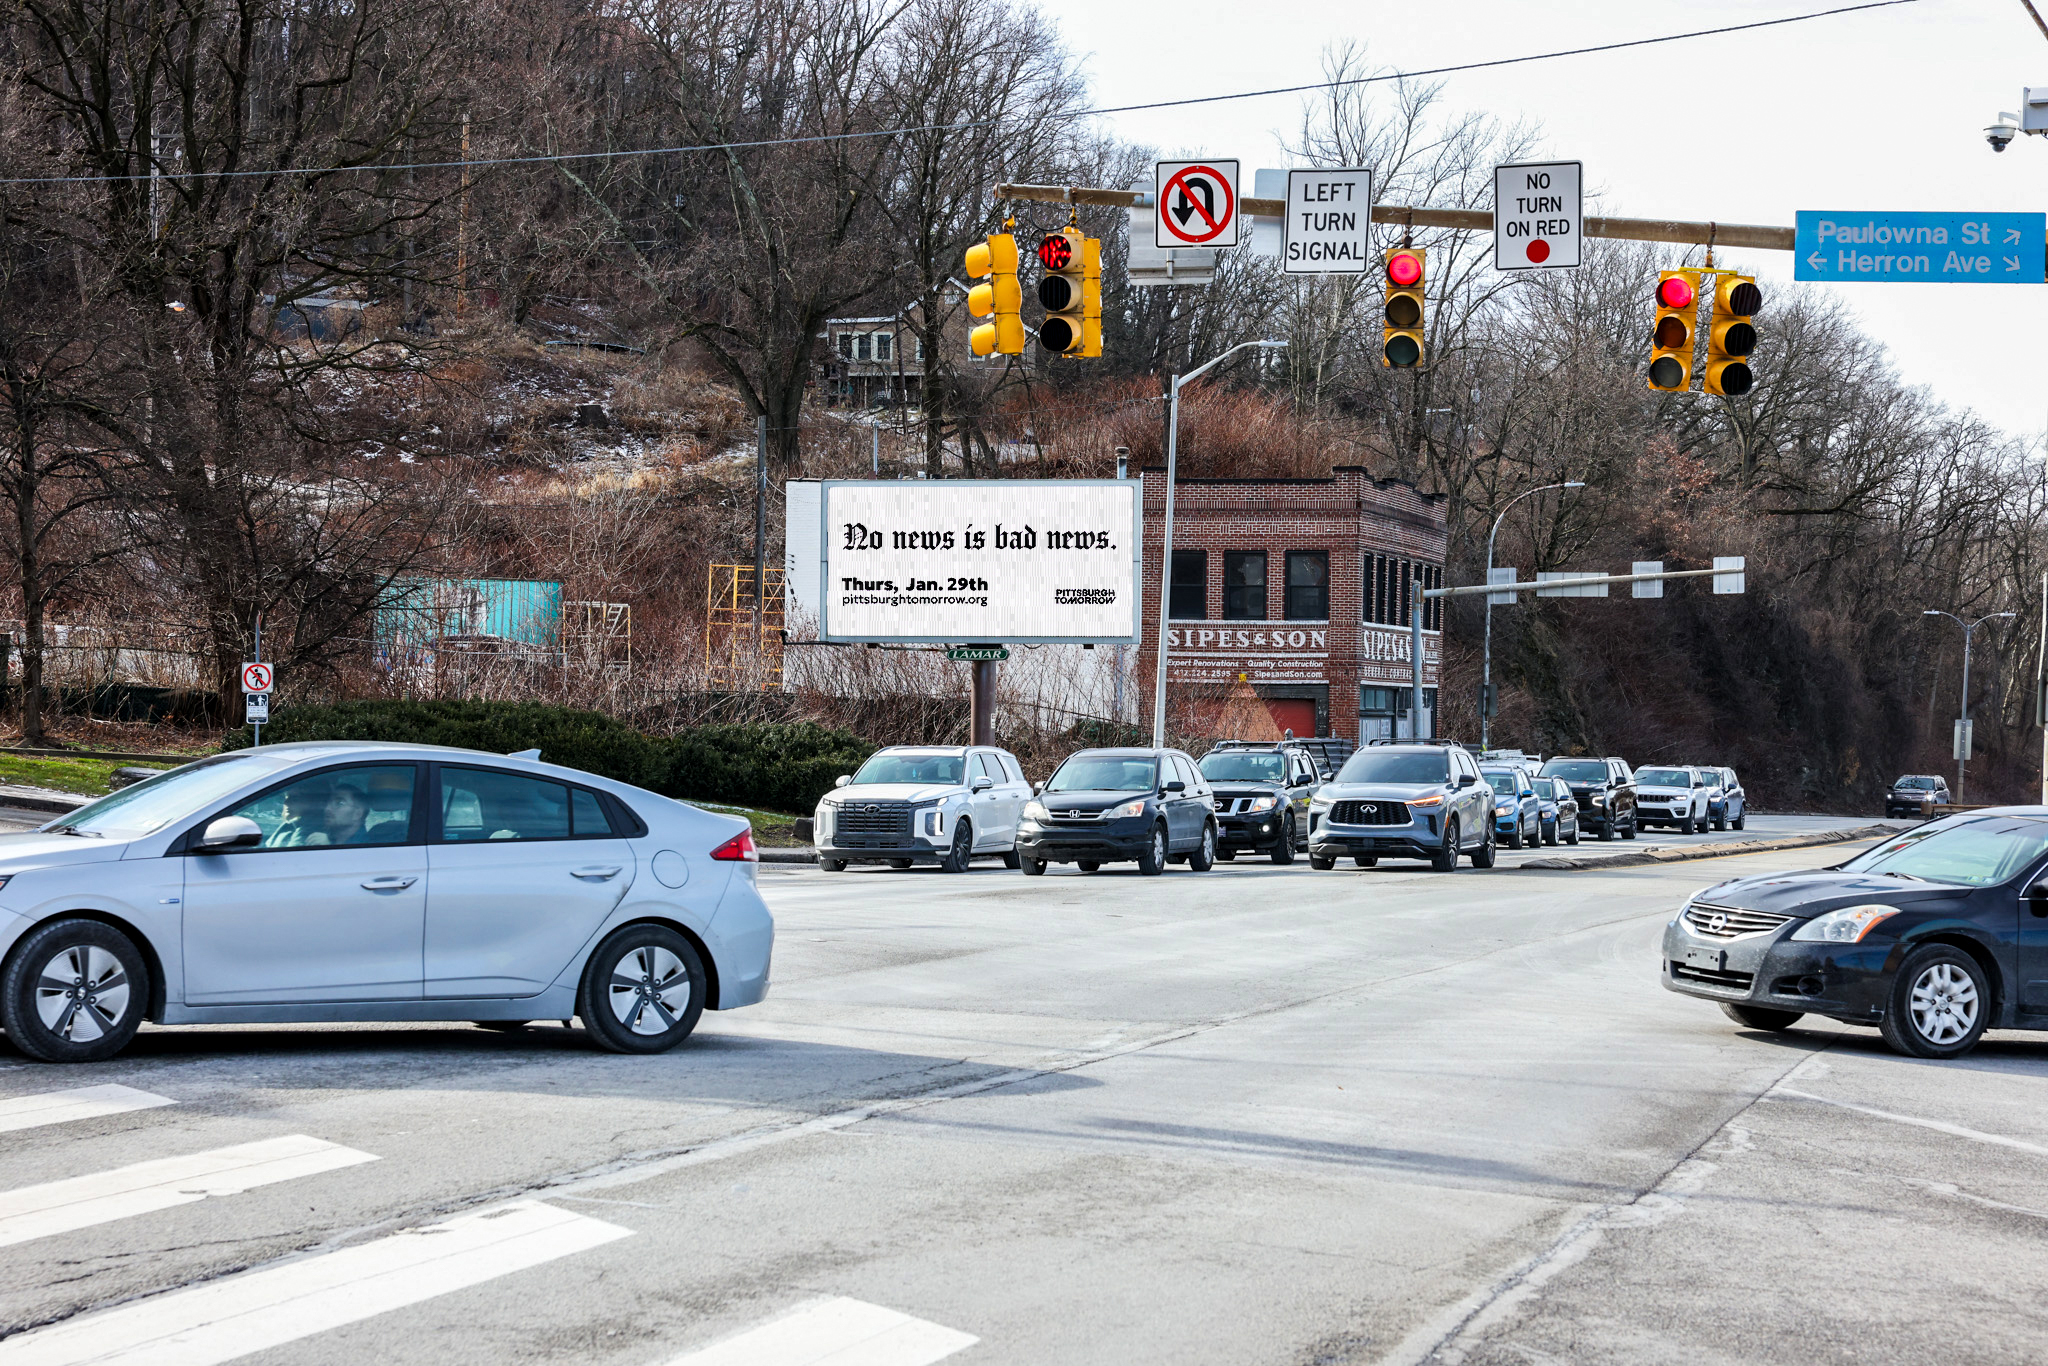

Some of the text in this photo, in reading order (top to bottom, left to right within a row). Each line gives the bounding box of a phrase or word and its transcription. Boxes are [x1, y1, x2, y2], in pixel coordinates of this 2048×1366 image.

[1526, 172, 1550, 190] NO
[1303, 182, 1356, 202] LEFT
[1516, 196, 1562, 214] TURN
[1301, 212, 1356, 232] TURN
[1506, 218, 1570, 238] ON RED
[1818, 220, 1991, 244] Paulowna St
[1288, 242, 1364, 262] SIGNAL
[1837, 249, 1992, 273] Herron Ave
[842, 522, 1117, 551] No news is bad news.
[842, 577, 989, 594] Thurs, Jan. 29th
[1055, 588, 1116, 597] PITTSBURGH
[842, 594, 989, 607] pittsburghtomorrow.org
[1054, 596, 1116, 605] TOMORROW
[952, 650, 1002, 659] LAMAR
[1167, 658, 1324, 669] Expert Renovations Quality Construction
[1254, 670, 1323, 679] SipesandSon.com
